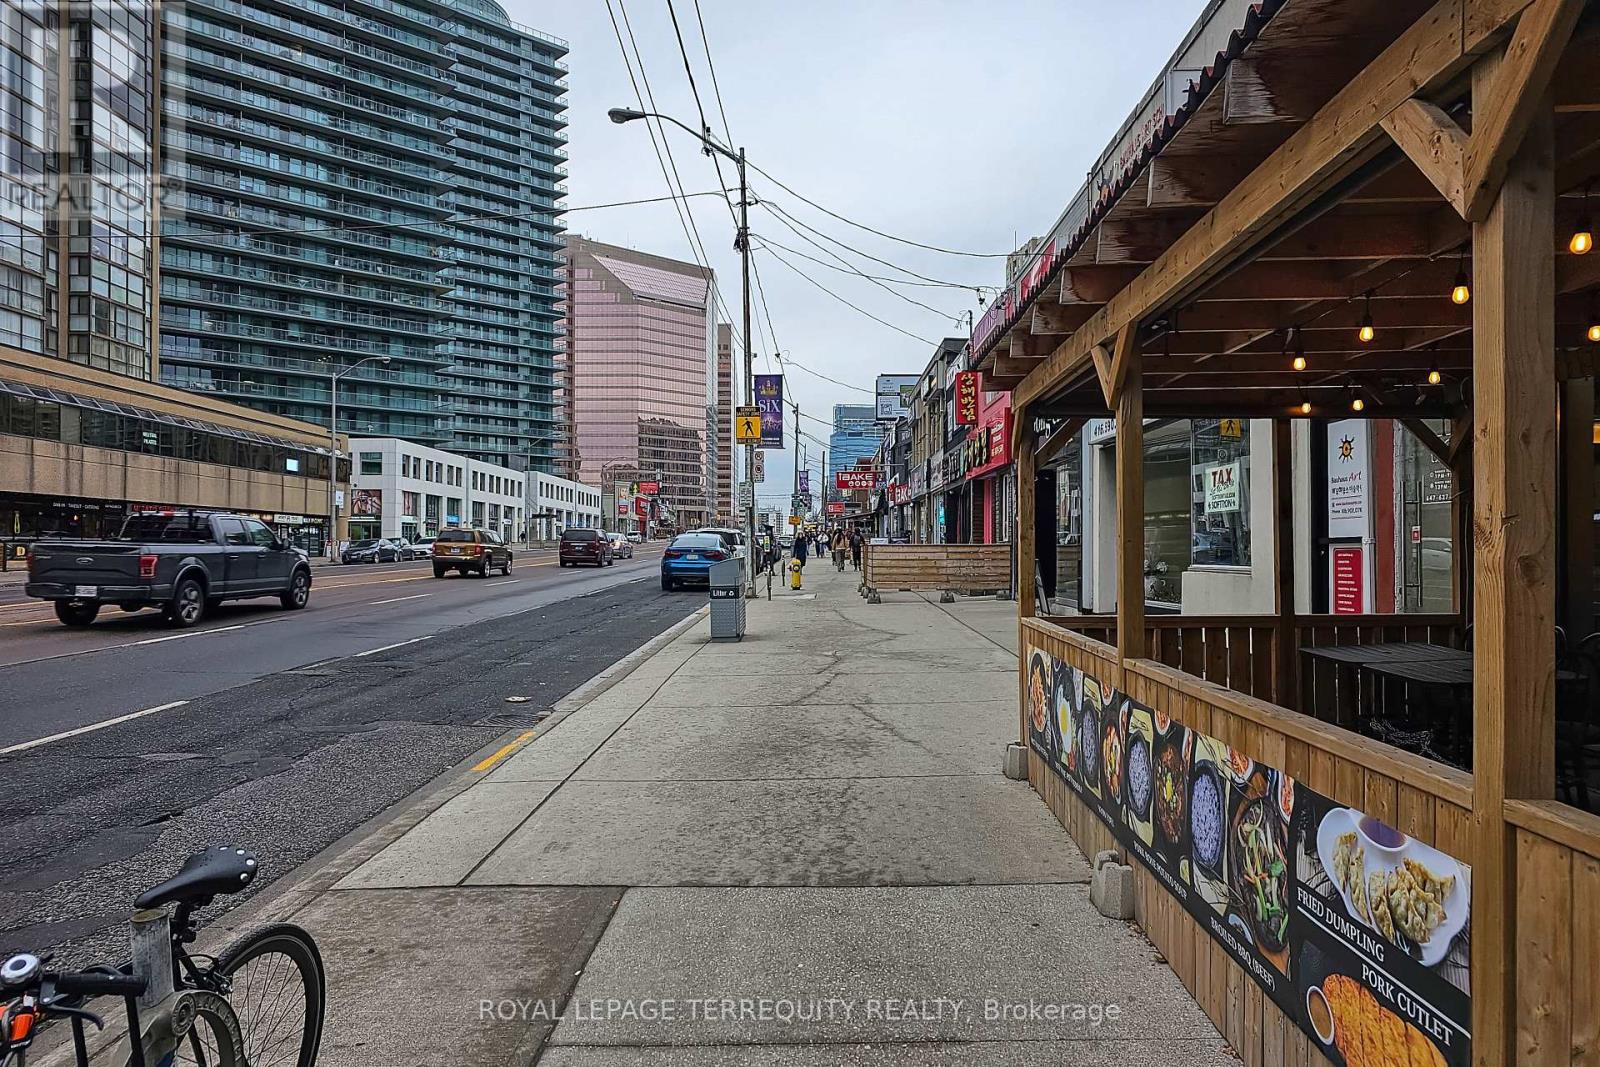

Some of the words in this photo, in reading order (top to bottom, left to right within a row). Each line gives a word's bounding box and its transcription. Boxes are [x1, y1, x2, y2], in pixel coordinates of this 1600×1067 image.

[1211, 467, 1233, 488] TAX
[1210, 916, 1238, 951] BROILED
[1237, 942, 1253, 970] BBQ
[1252, 957, 1276, 992] (BEEF)
[1297, 886, 1324, 917] FRIED
[1325, 907, 1385, 962] DUMPLING
[1361, 963, 1396, 1003] PORK
[1396, 992, 1453, 1047] CUTLET
